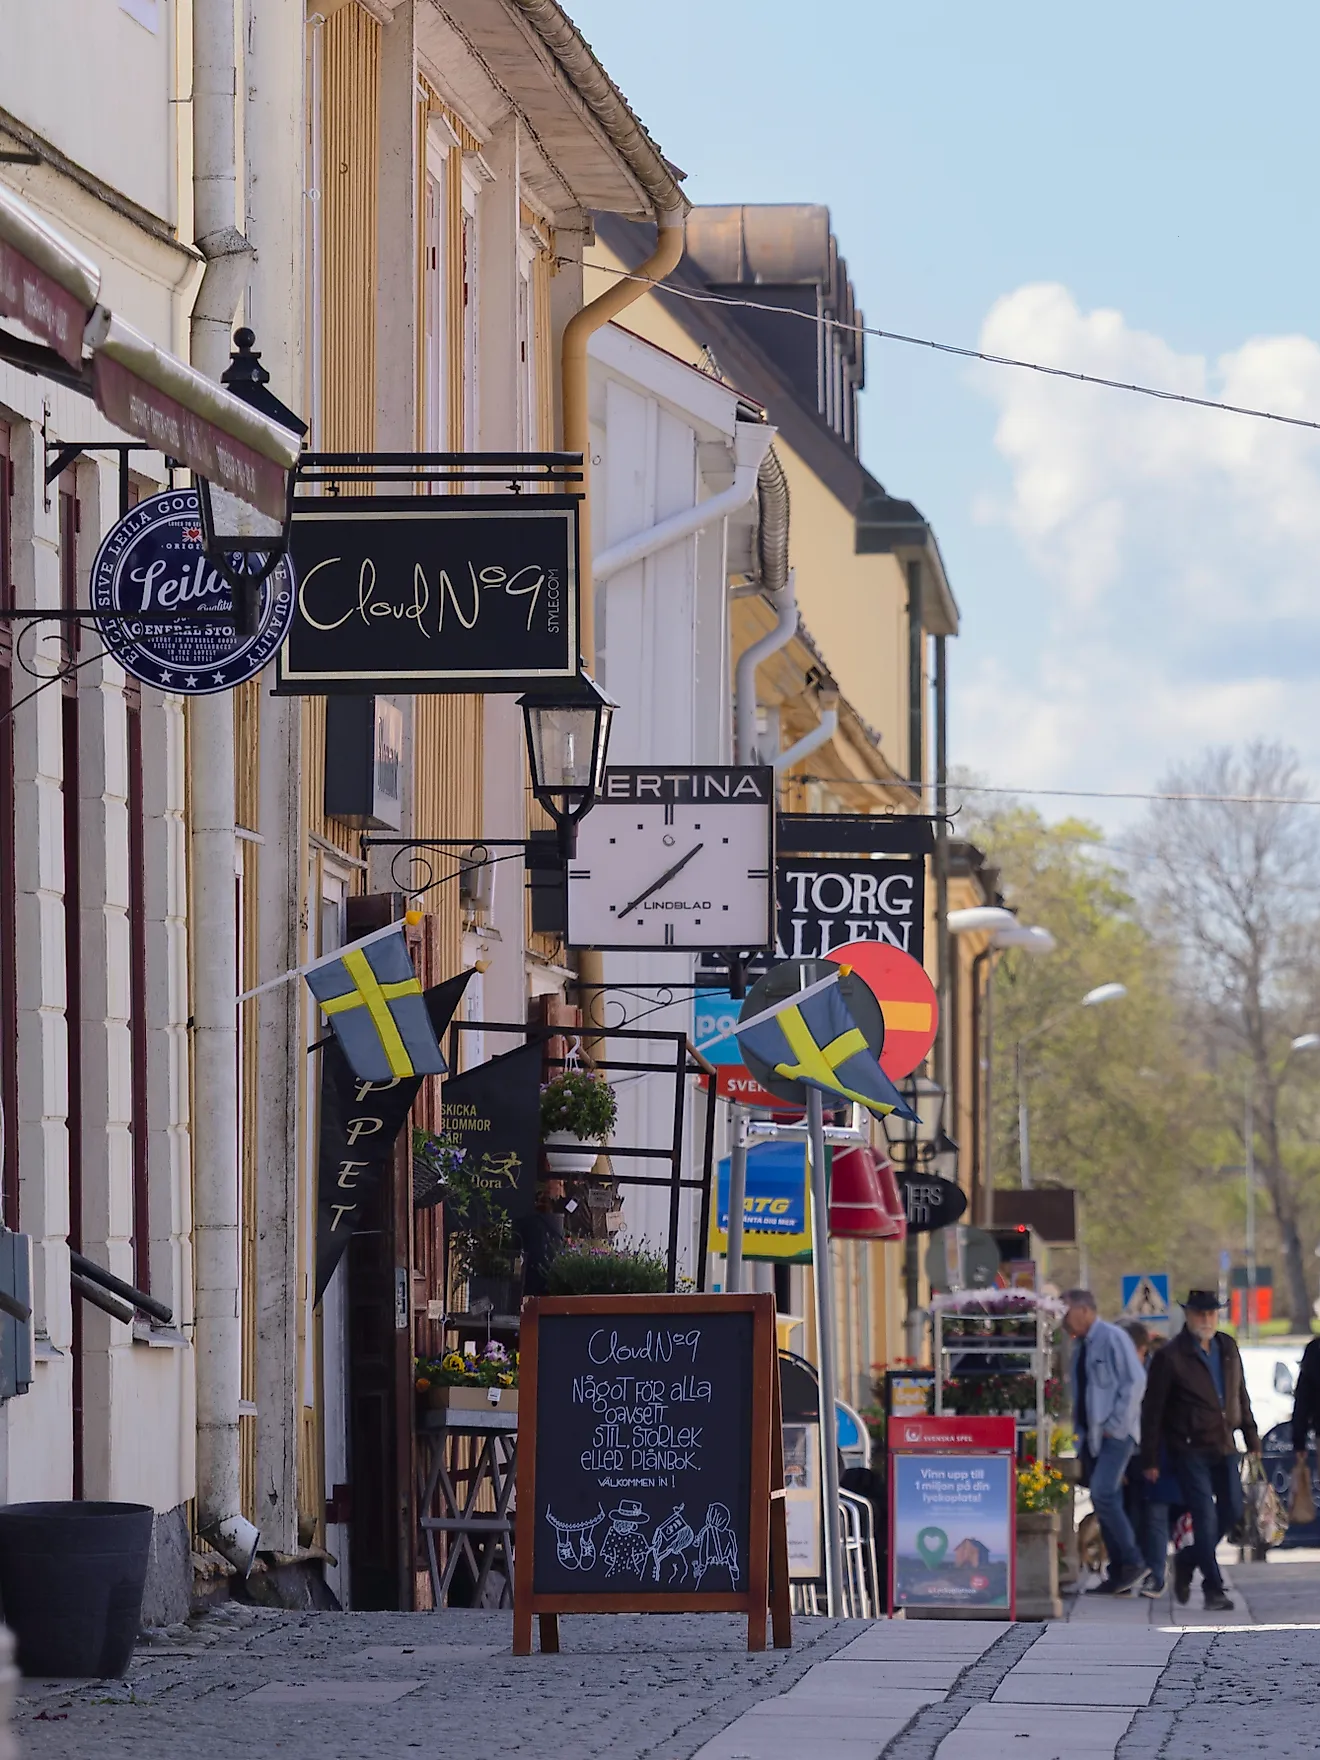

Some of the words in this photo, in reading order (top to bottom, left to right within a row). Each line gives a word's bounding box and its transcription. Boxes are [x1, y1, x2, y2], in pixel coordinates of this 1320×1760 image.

[108, 510, 153, 557] LEILA
[157, 495, 199, 515] GOO
[547, 567, 560, 634] STYLE.COM
[204, 623, 235, 636] STO
[245, 590, 291, 668] QUALITY
[607, 775, 763, 798] ERTINA
[786, 871, 914, 915] TORG
[643, 901, 712, 911] LINDBLAD
[957, 1434, 973, 1442] SPEL
[598, 1476, 655, 1488] VÄLKOMMEN
[920, 1468, 945, 1479] Vinn
[947, 1471, 969, 1482] upp
[971, 1468, 985, 1479] till
[915, 1481, 920, 1491] 1
[922, 1481, 954, 1493] miljon
[956, 1480, 971, 1493] på
[973, 1481, 991, 1491] din
